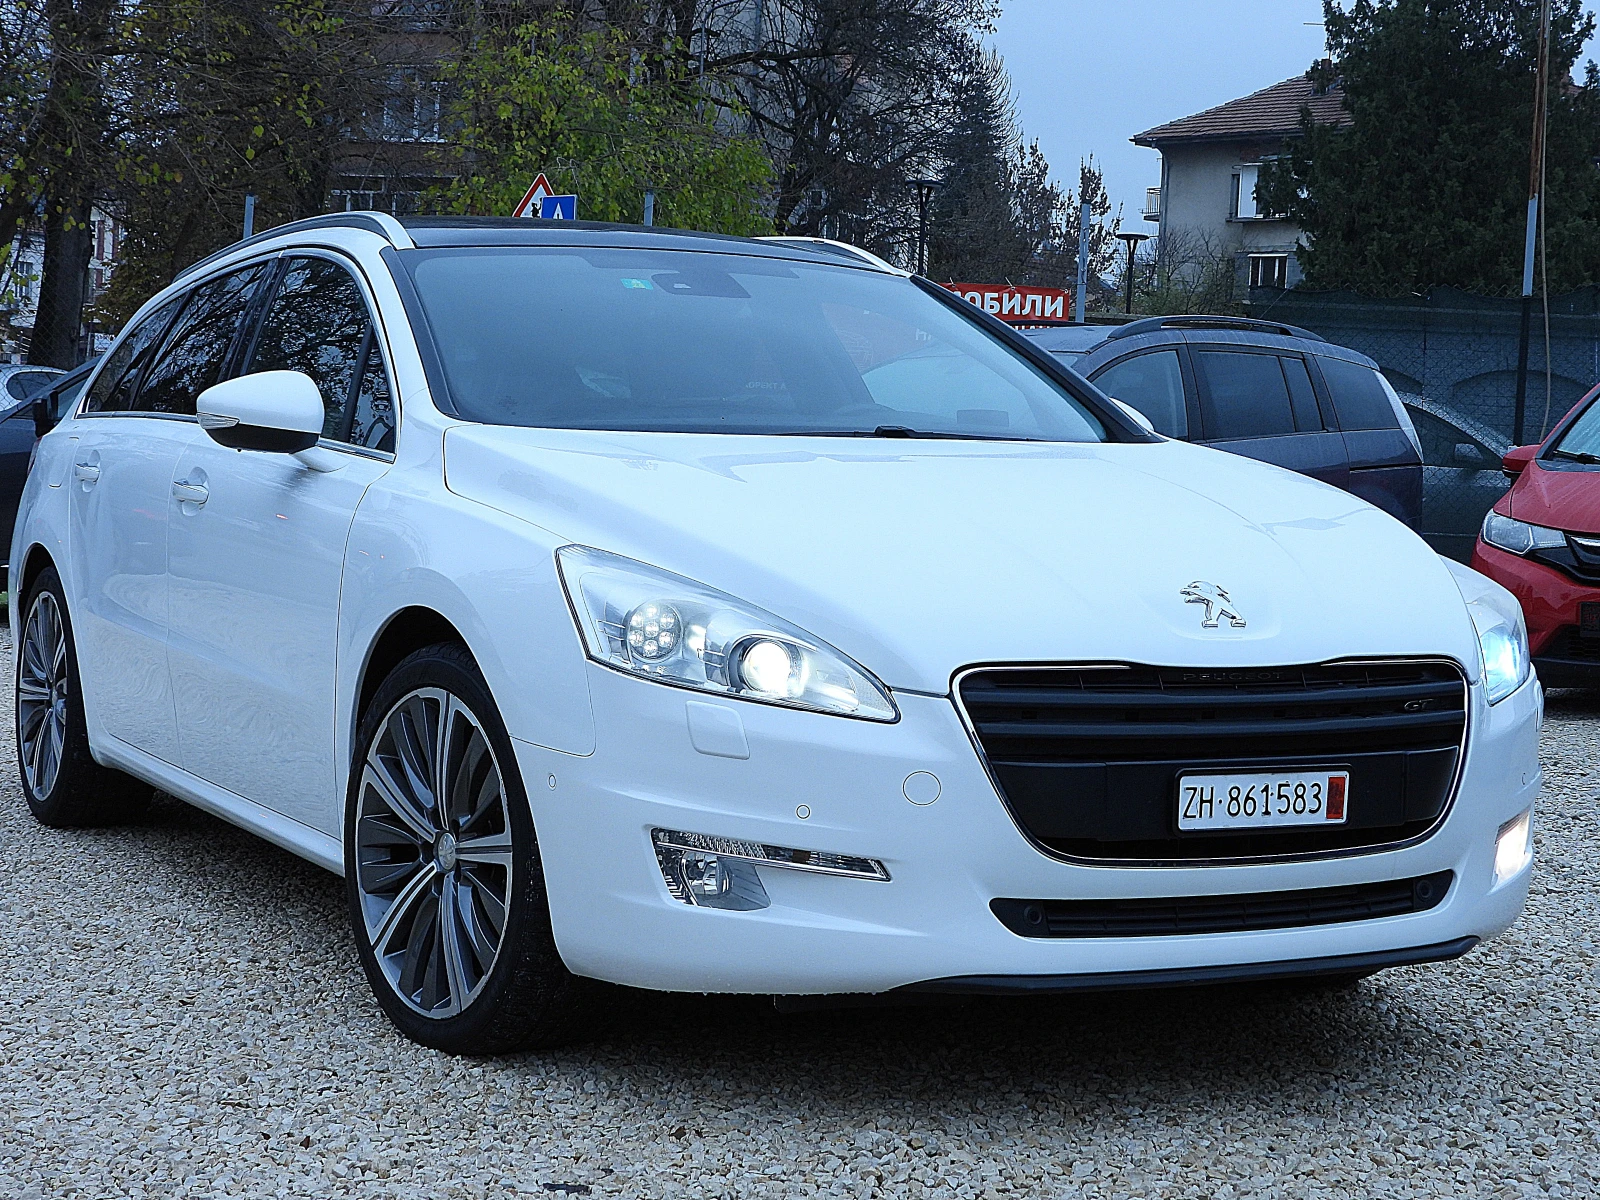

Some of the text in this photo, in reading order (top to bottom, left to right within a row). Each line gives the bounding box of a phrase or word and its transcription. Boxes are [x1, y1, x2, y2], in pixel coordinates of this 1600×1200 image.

[953, 291, 1064, 318] ОБИЛИ
[1183, 671, 1283, 681] PEUGEOT
[1403, 698, 1434, 711] GT
